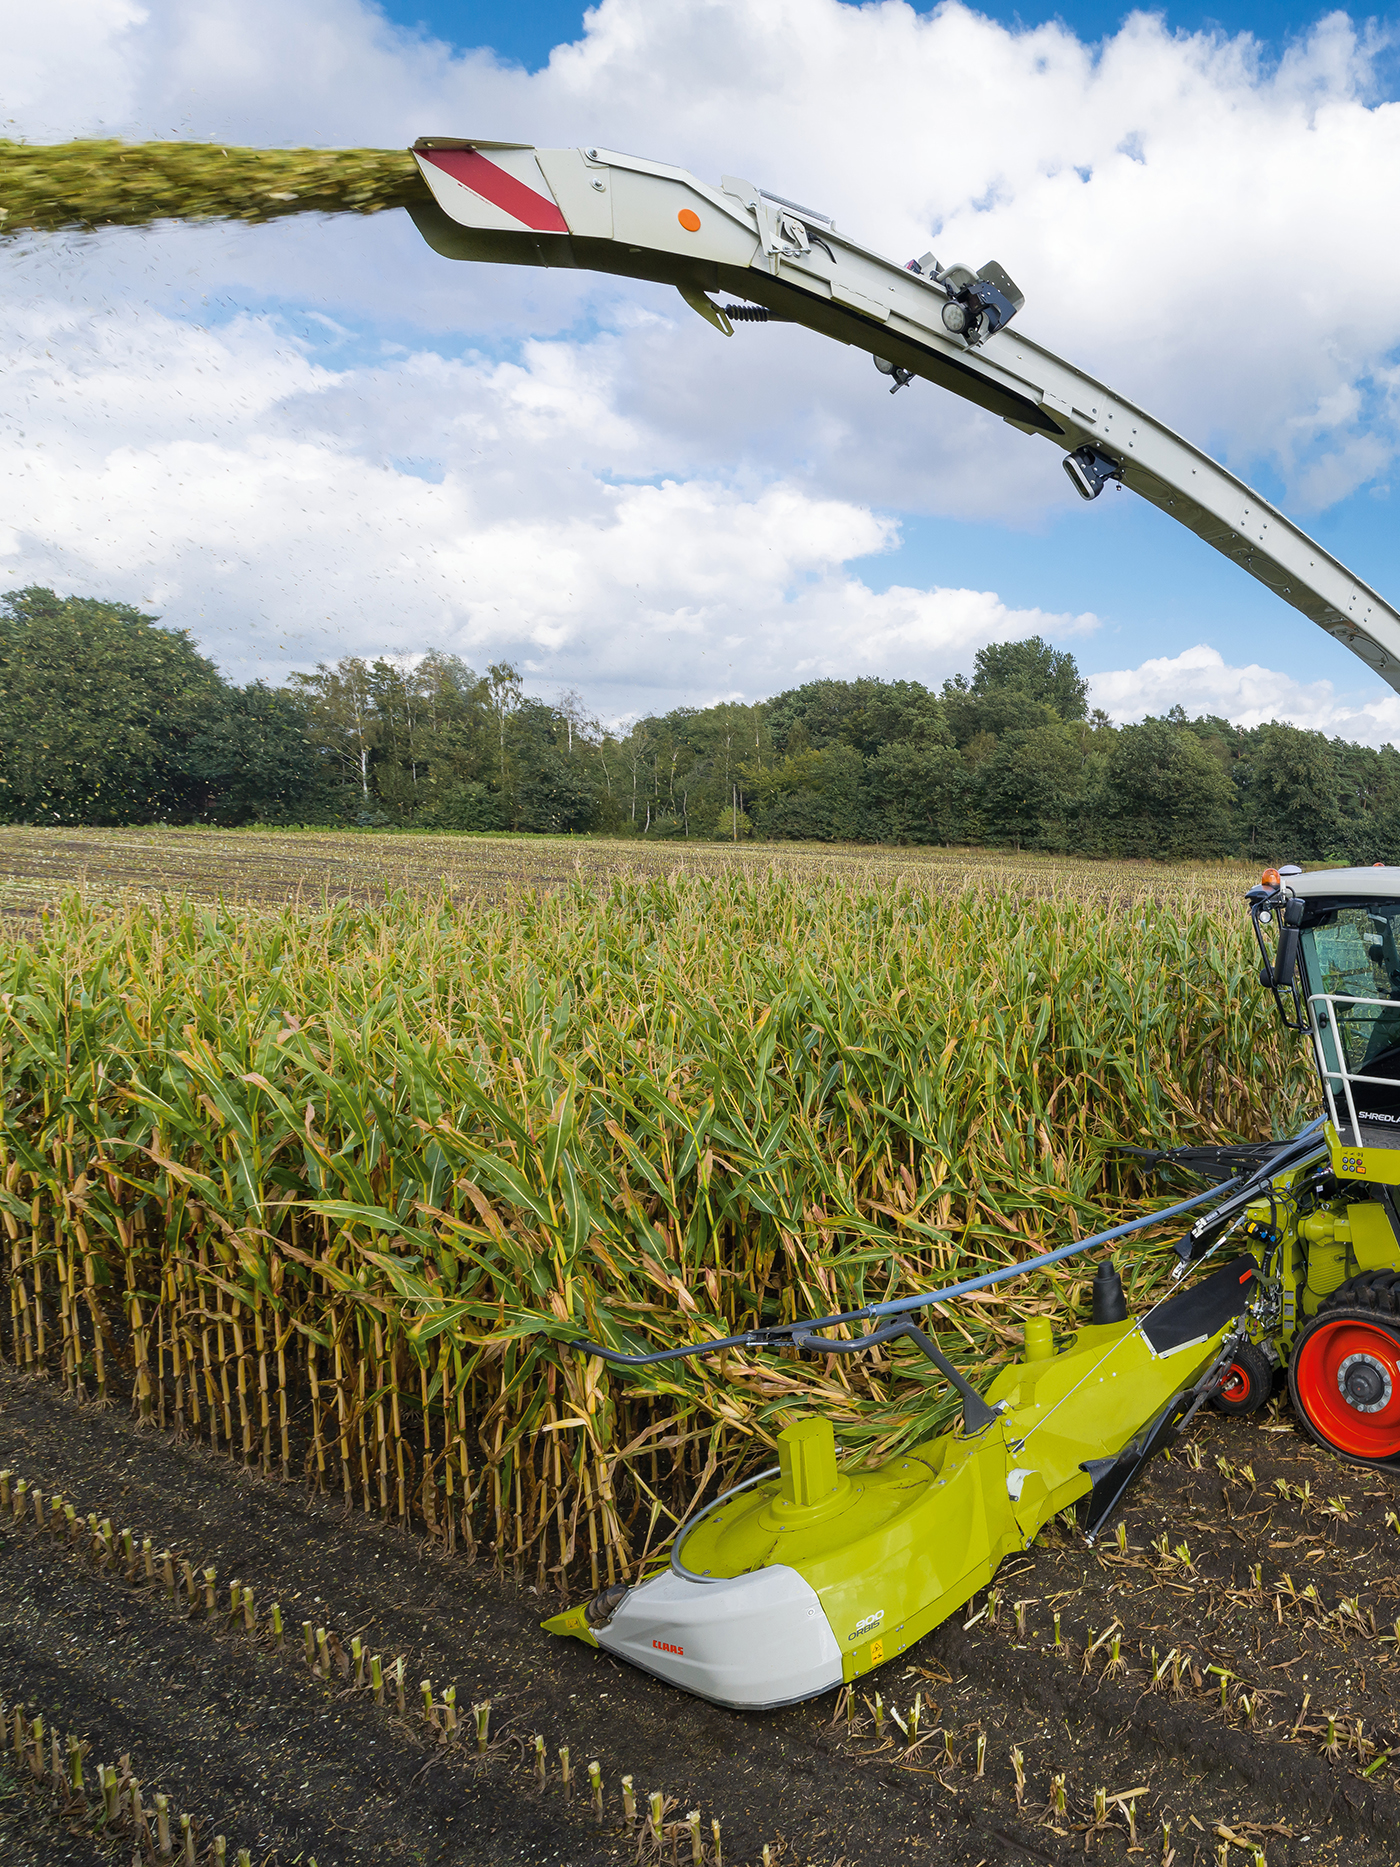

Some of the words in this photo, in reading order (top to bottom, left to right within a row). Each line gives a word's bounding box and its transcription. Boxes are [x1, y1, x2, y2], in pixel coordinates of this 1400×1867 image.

[848, 1618, 880, 1641] ORBIS
[855, 1609, 884, 1632] 900
[652, 1640, 684, 1656] CLAAS
